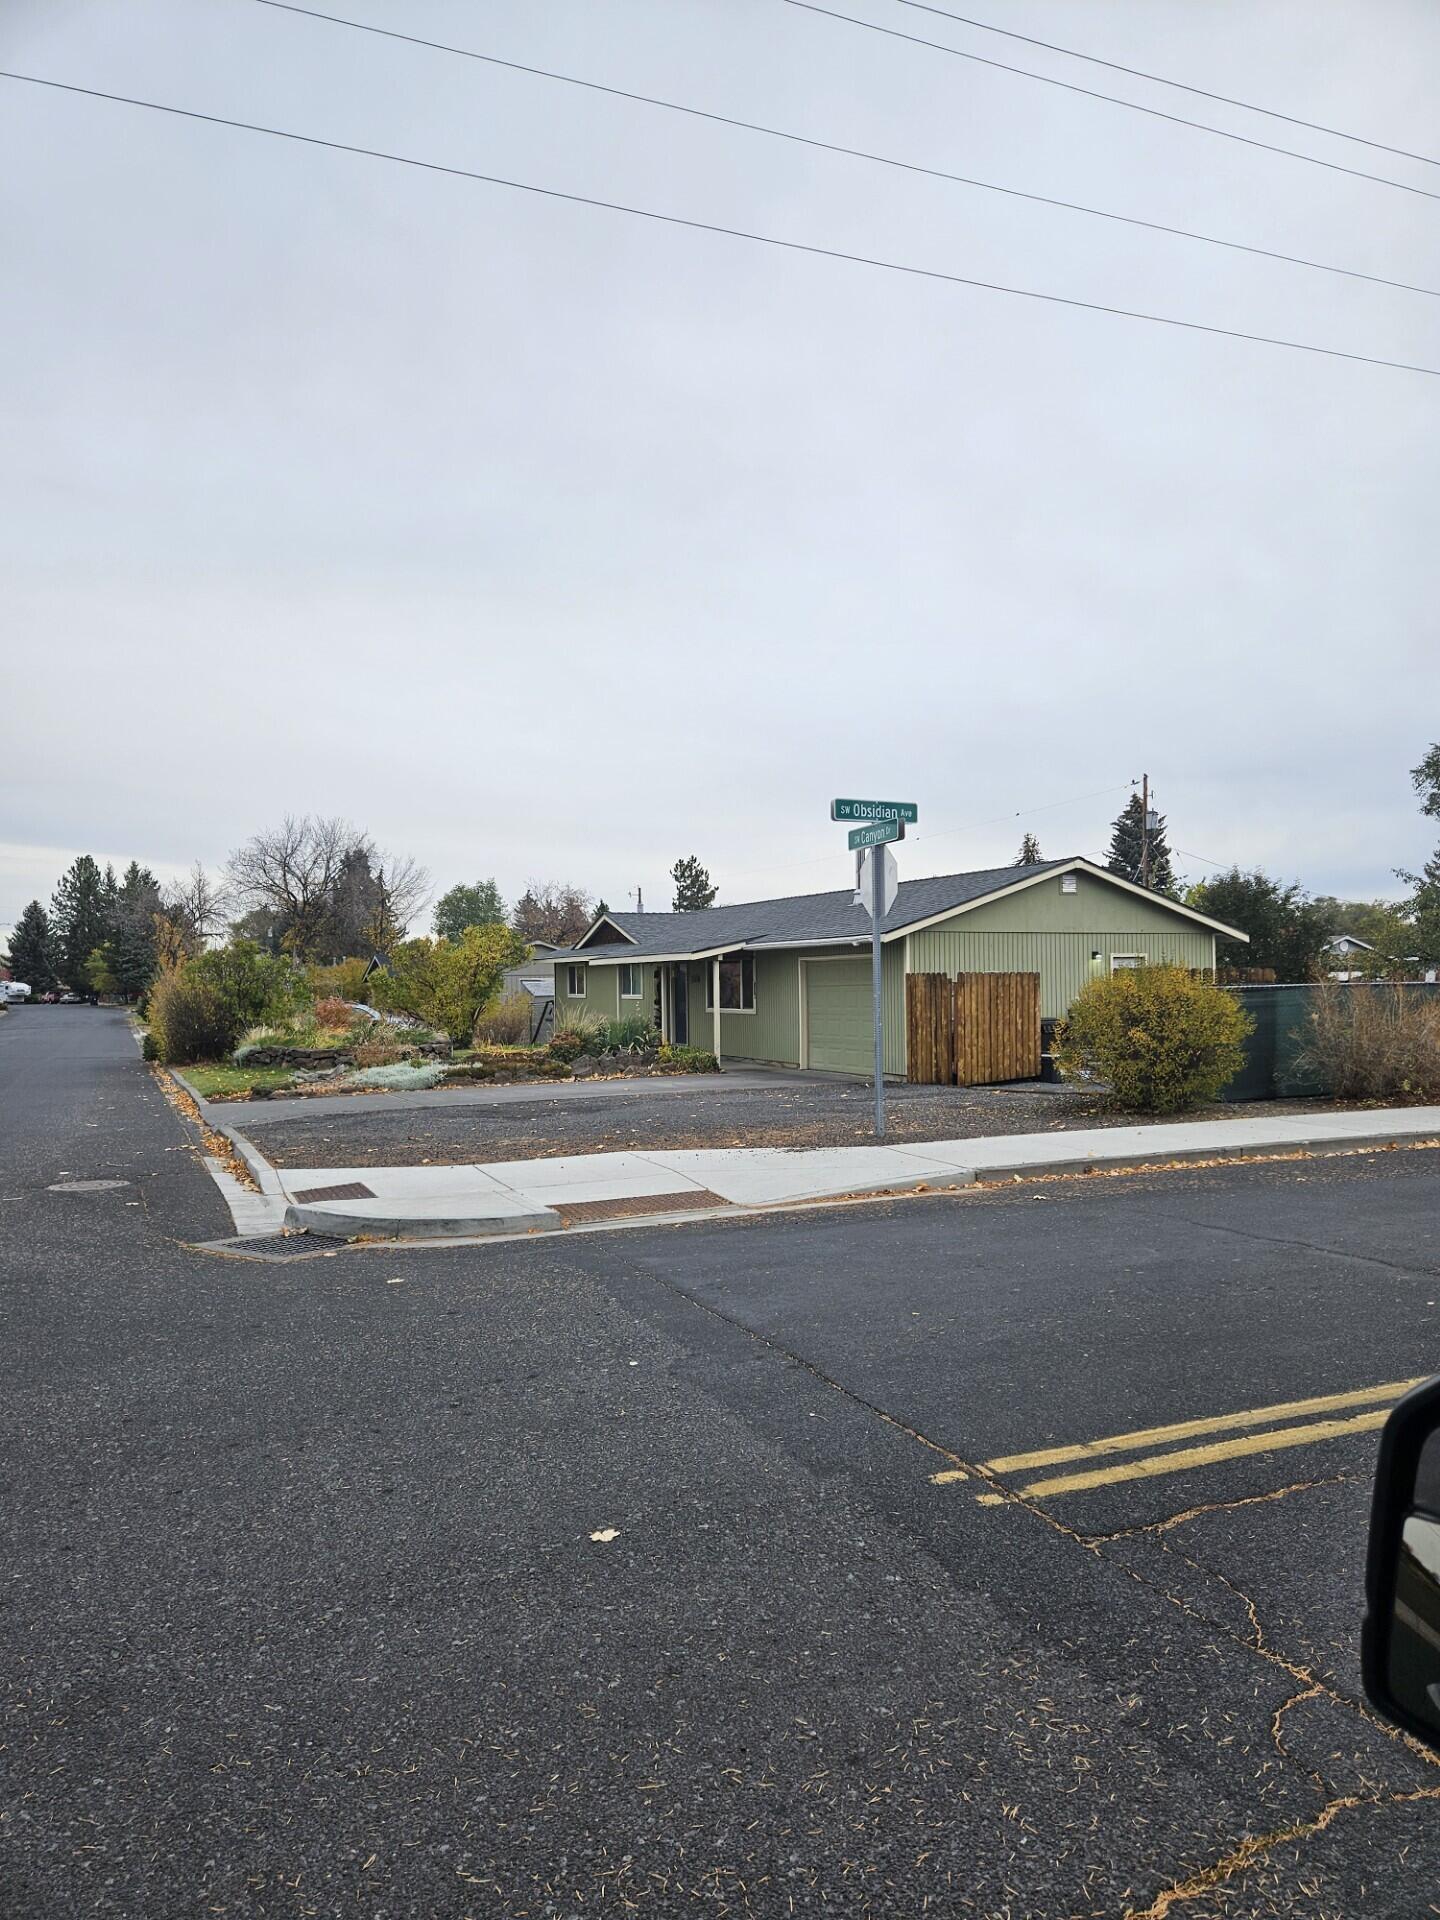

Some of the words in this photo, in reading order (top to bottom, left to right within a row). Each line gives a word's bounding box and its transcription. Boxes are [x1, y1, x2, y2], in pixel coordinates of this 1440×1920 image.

[840, 804, 850, 814] SW
[853, 803, 897, 819] Obsidian
[900, 809, 912, 818] Ave
[861, 829, 885, 844] Canyon
[885, 826, 891, 835] Dr
